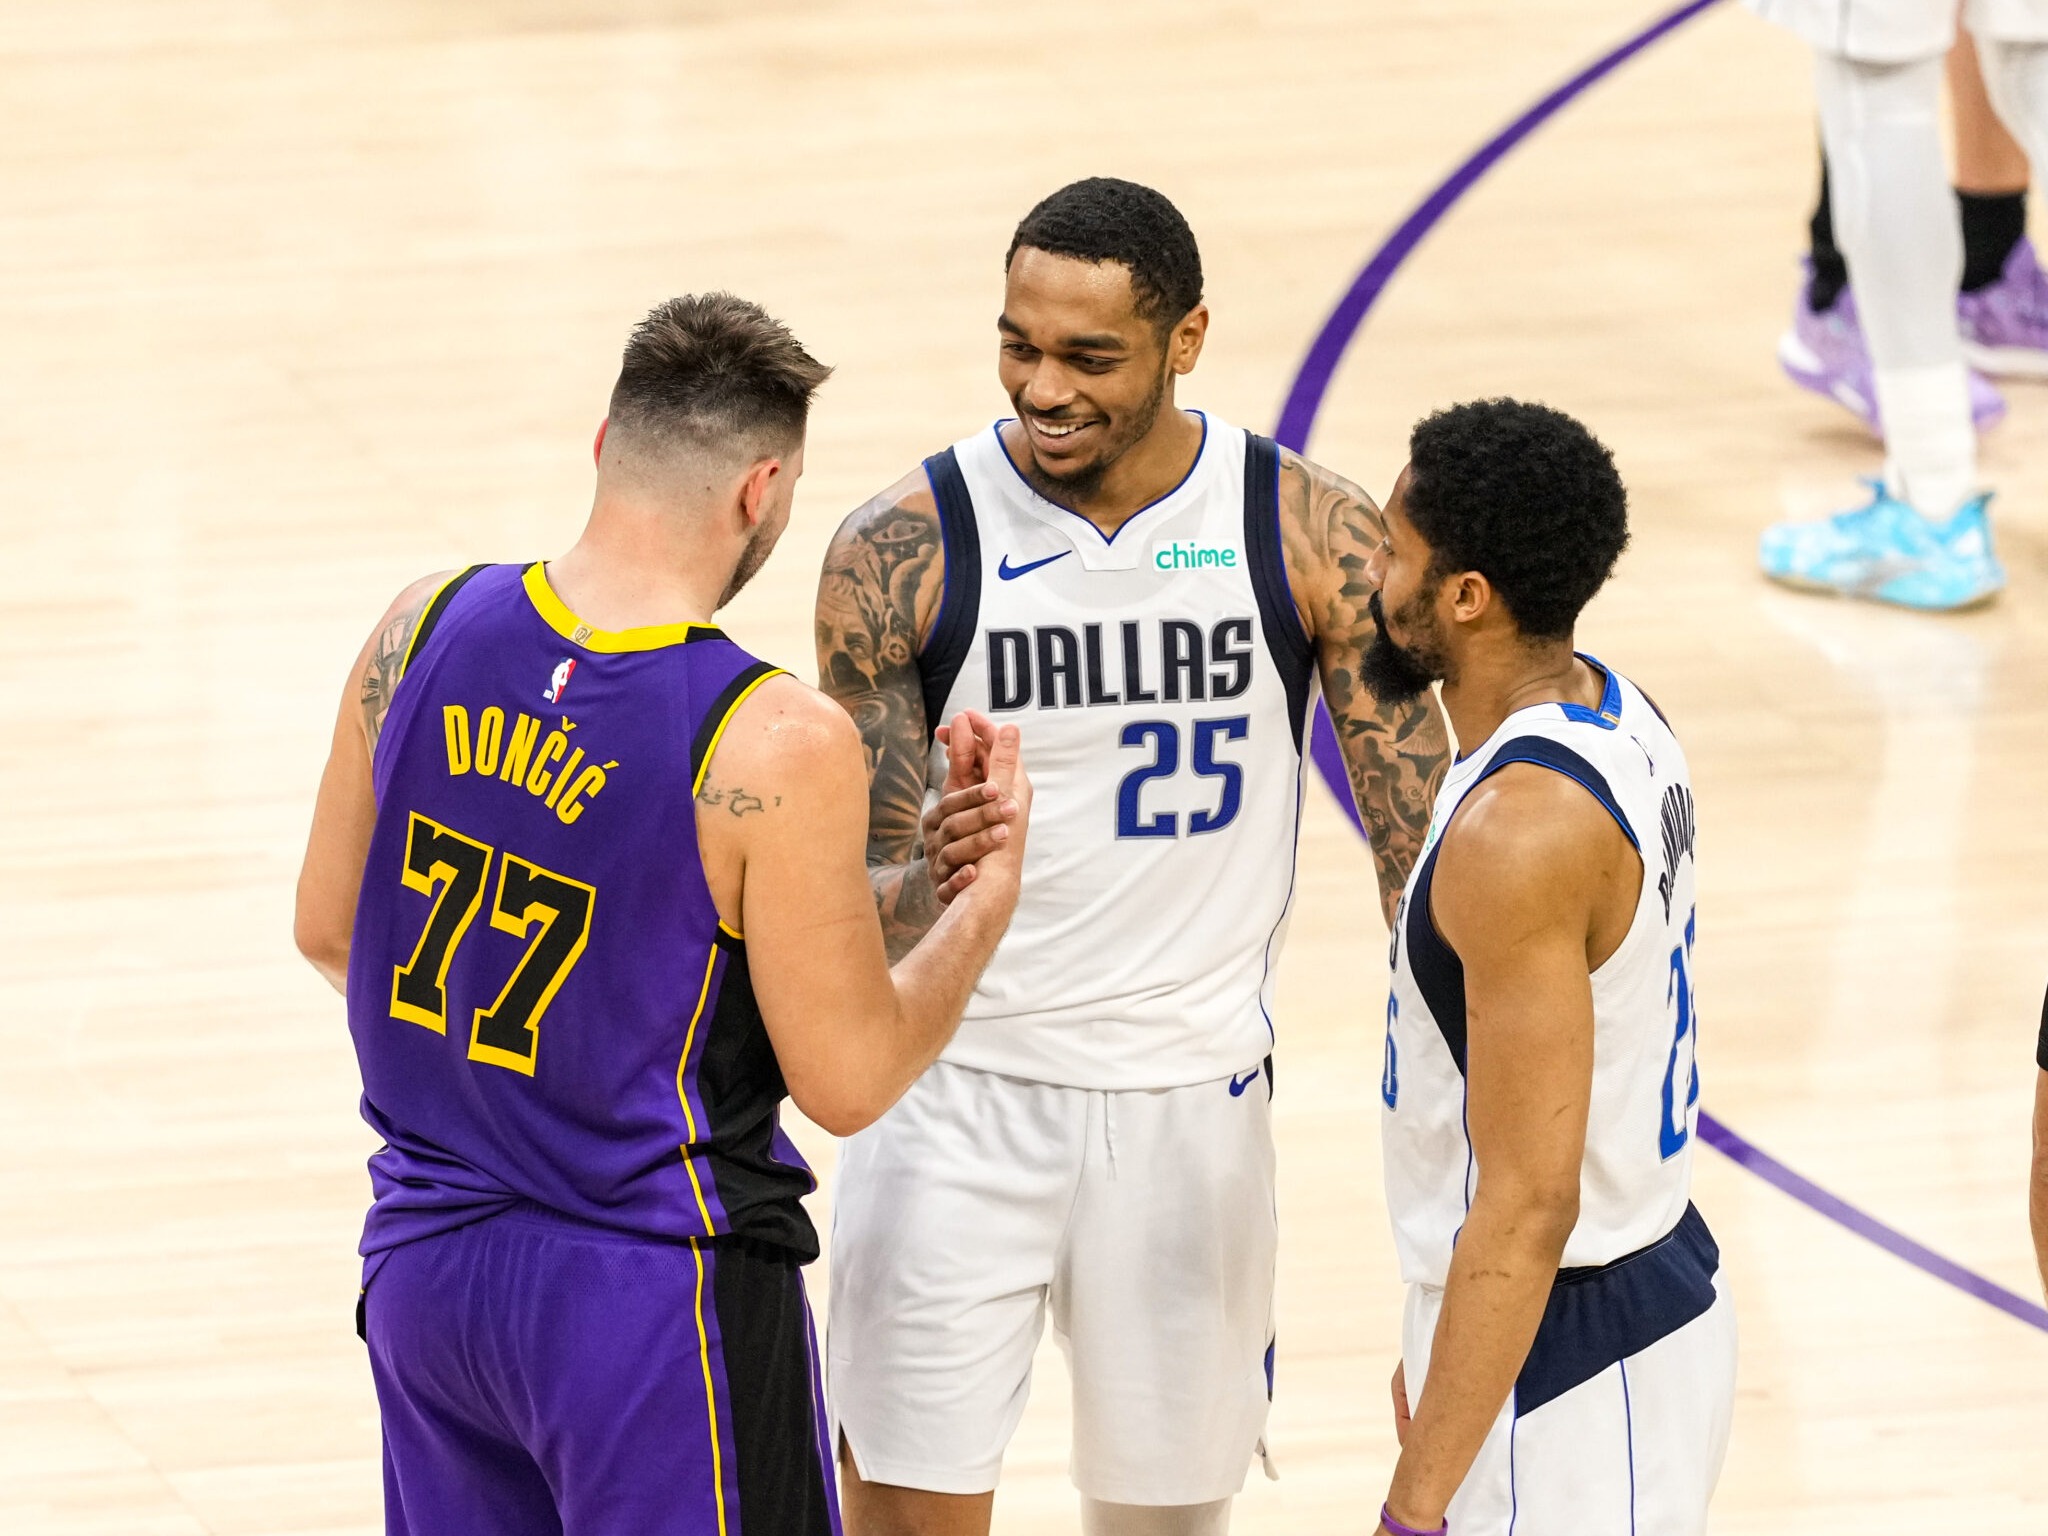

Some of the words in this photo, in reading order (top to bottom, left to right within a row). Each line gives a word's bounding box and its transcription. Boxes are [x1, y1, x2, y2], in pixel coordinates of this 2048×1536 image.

[1156, 543, 1237, 570] chime
[985, 616, 1254, 713] DALLAS
[443, 704, 620, 825] DONČIĆ
[1114, 714, 1251, 841] 25
[389, 810, 597, 1078] 77
